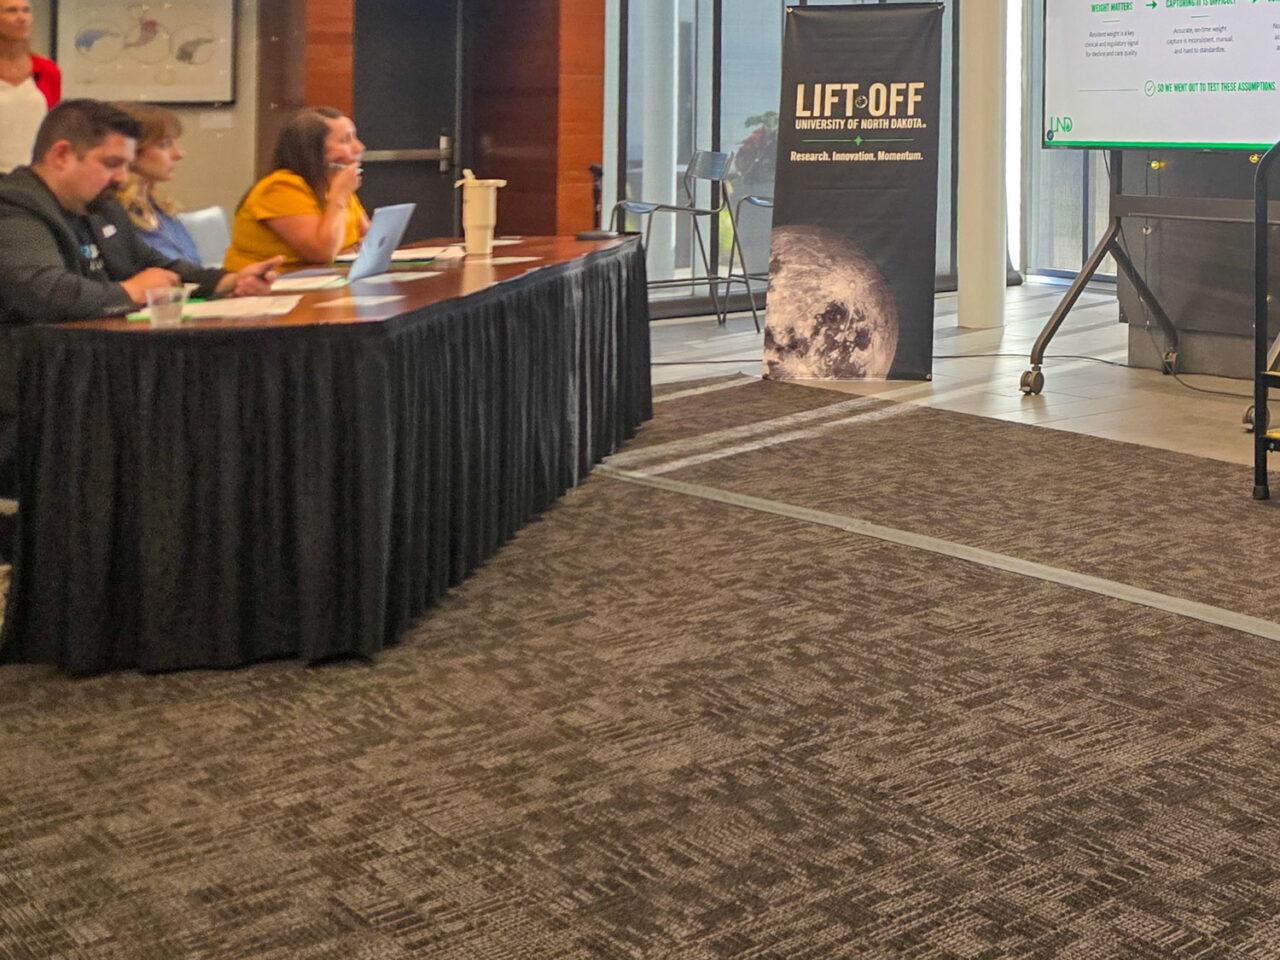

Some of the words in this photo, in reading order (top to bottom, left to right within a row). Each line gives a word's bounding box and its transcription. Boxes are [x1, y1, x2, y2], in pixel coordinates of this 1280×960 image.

[1091, 3, 1109, 12] WEIGHT
[1111, 2, 1133, 11] MATTERS
[1157, 83, 1164, 93] SO
[1165, 83, 1172, 92] WE
[1174, 83, 1187, 92] WENT
[1188, 82, 1198, 92] OUT
[1199, 82, 1206, 92] TO
[1207, 82, 1220, 92] TEST
[1221, 82, 1237, 92] THESE
[796, 83, 859, 117] LIFT
[868, 82, 925, 117] OFF
[795, 118, 845, 130] UNIVERSITY
[847, 118, 859, 130] OF
[861, 118, 889, 129] NORTH
[790, 150, 831, 162] Research.
[832, 151, 876, 161] Innovation.
[878, 151, 924, 161] Momentum.
